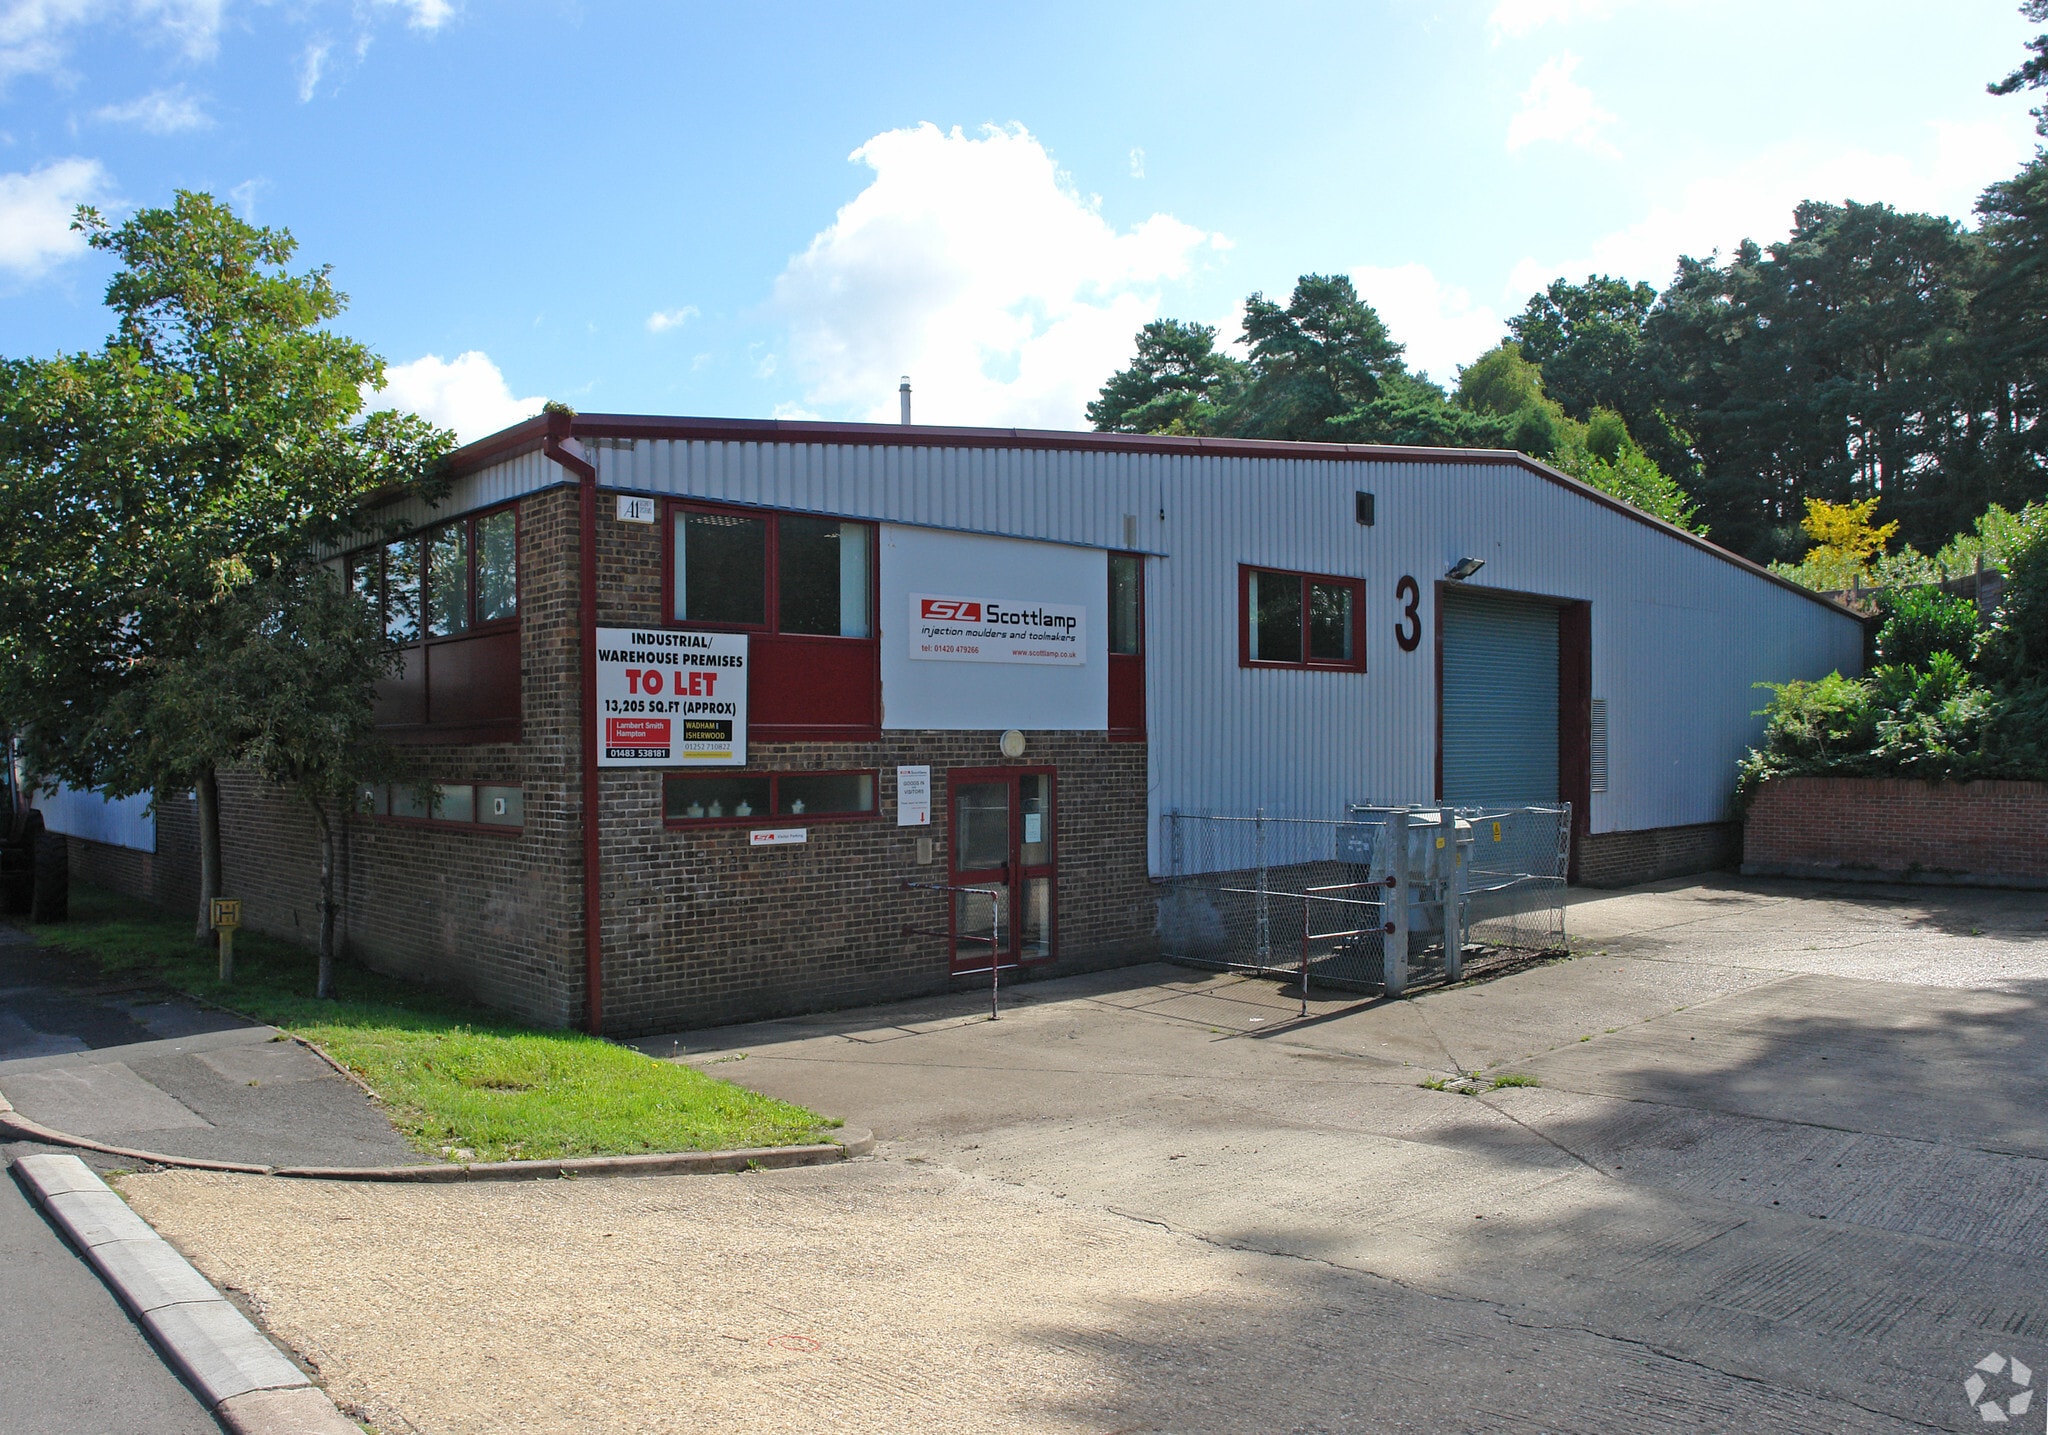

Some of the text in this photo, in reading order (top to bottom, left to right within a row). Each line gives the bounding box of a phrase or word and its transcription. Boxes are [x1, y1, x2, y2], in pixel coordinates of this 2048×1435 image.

[924, 601, 977, 620] SL
[1395, 575, 1421, 652] 3
[987, 604, 1076, 634] Scottlamp
[631, 632, 713, 649] INDUSTRIAL/
[921, 625, 1076, 642] injection moulders and toolmakers
[934, 645, 954, 653] 01420
[956, 646, 979, 654] 479266
[1012, 649, 1076, 658] www.scottlamp.co.uk
[598, 649, 743, 667] WAREHOUSE PREMISES
[625, 669, 717, 696] TO LET
[605, 700, 736, 716] 13,205 SQ.FT (APPROX)
[616, 721, 664, 729] Lambert Smith
[685, 721, 715, 729] WADHAM
[616, 730, 646, 738] Hampton
[685, 731, 725, 739] ISHERWOOD
[610, 749, 666, 757] 01483 538181
[219, 903, 236, 923] H
